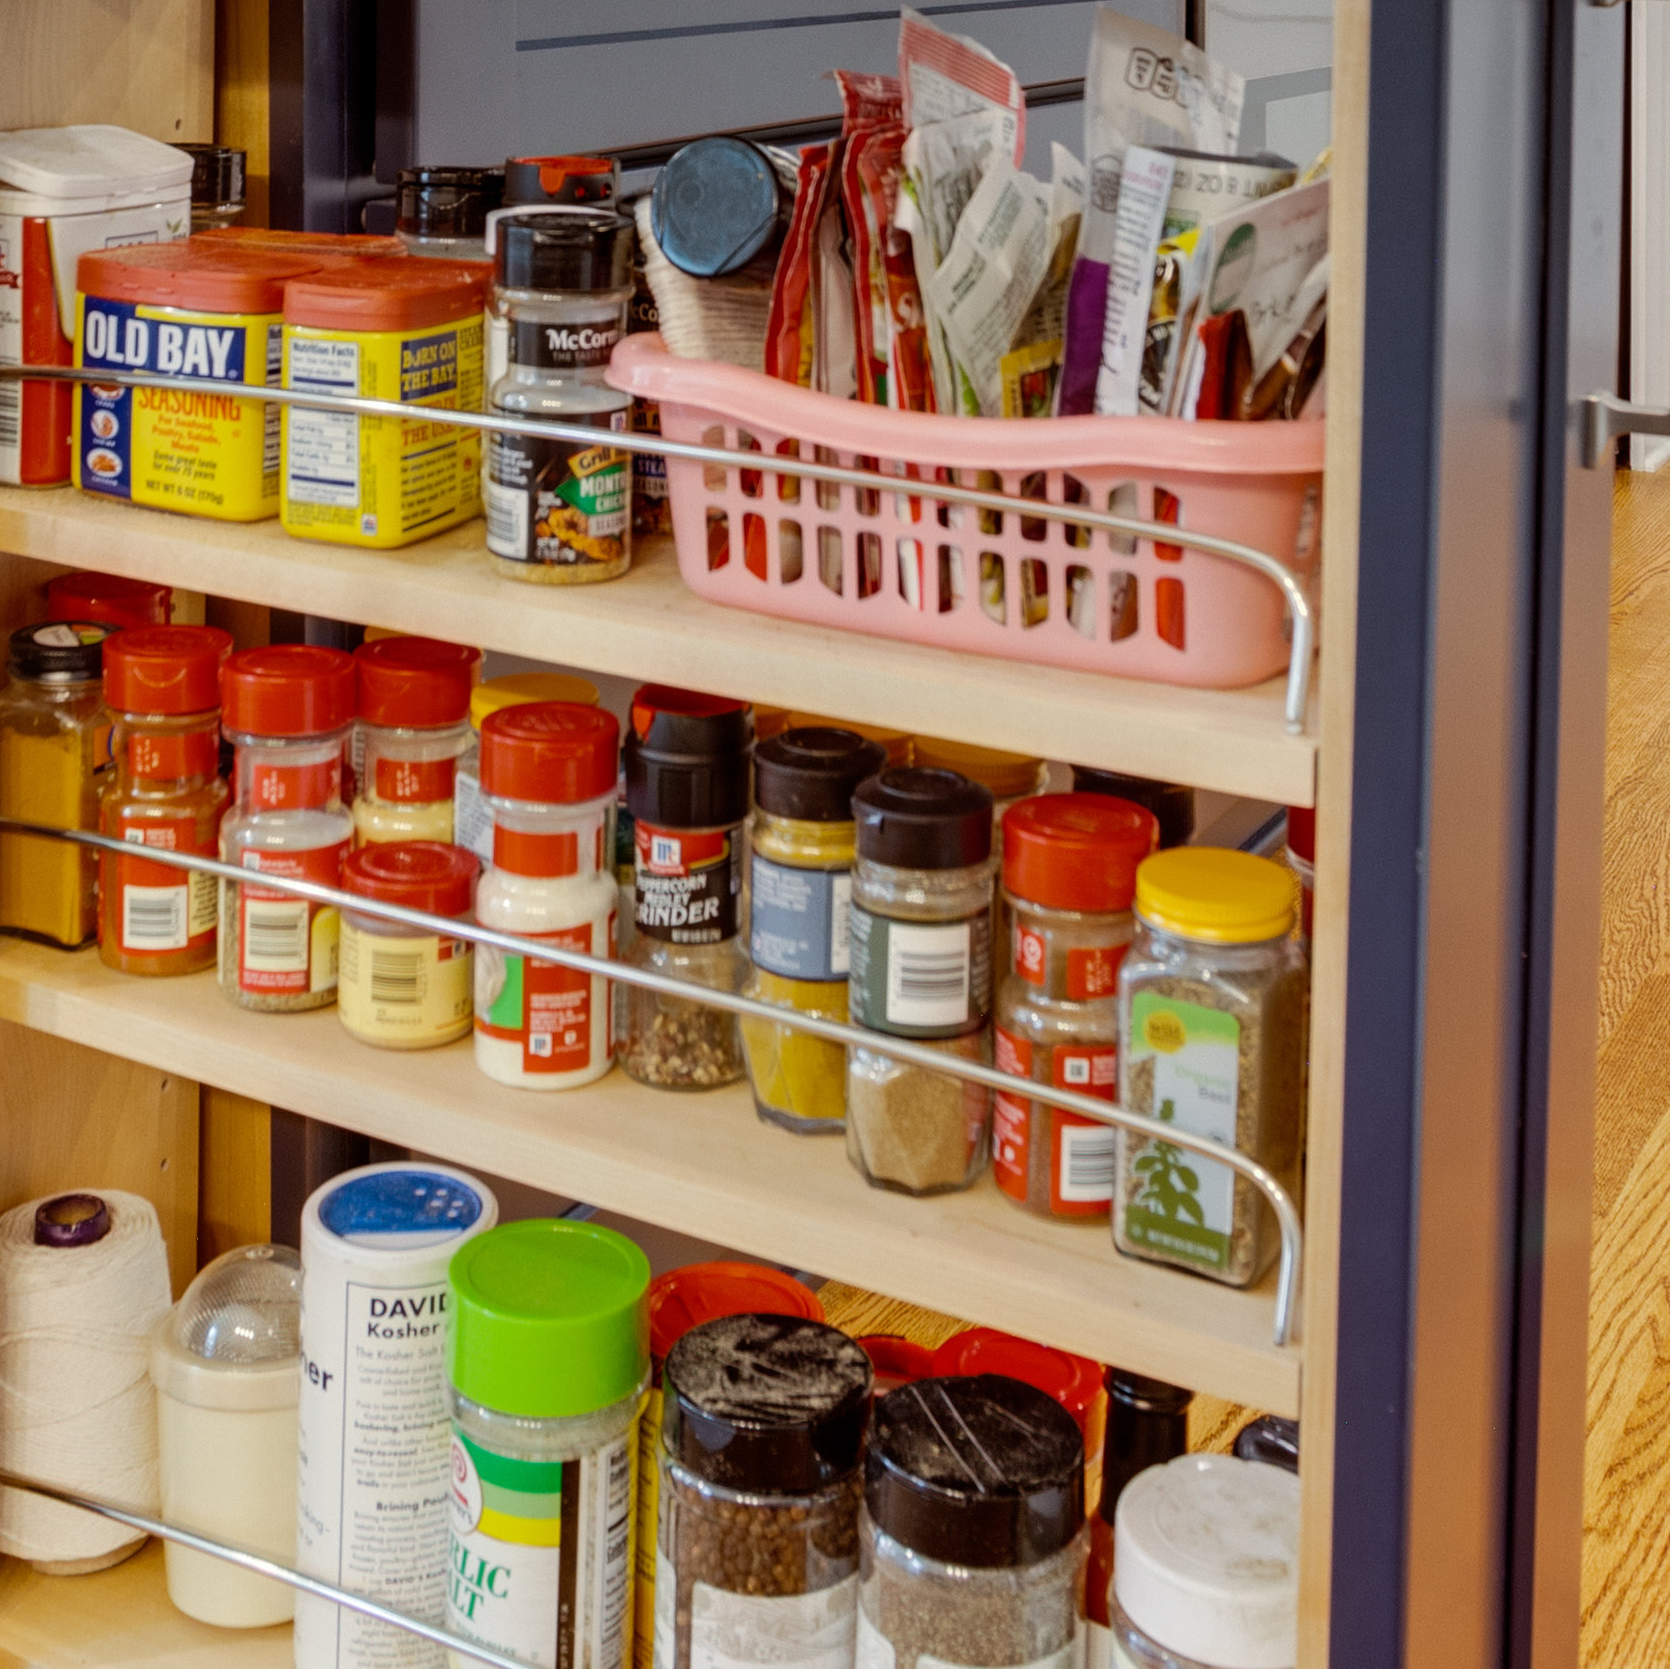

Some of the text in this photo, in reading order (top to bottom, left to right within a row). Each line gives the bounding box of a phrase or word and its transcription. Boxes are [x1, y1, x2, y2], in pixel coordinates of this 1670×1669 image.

[1196, 173, 1223, 195] OZ
[86, 310, 235, 378] OLD BAY
[293, 342, 355, 357] Nutrition Facts
[440, 340, 456, 362] ON
[402, 369, 429, 393] THE
[139, 386, 242, 421] SEASONING
[158, 414, 172, 425] For
[401, 425, 428, 447] THE
[171, 441, 200, 453] Meats
[579, 446, 611, 471] Grill
[146, 480, 161, 491] NET
[163, 482, 176, 493] WT
[184, 485, 196, 496] OZ
[367, 1321, 440, 1339] Kosher
[356, 1346, 438, 1360] The Kosher Salt
[376, 1501, 419, 1513] Brining
